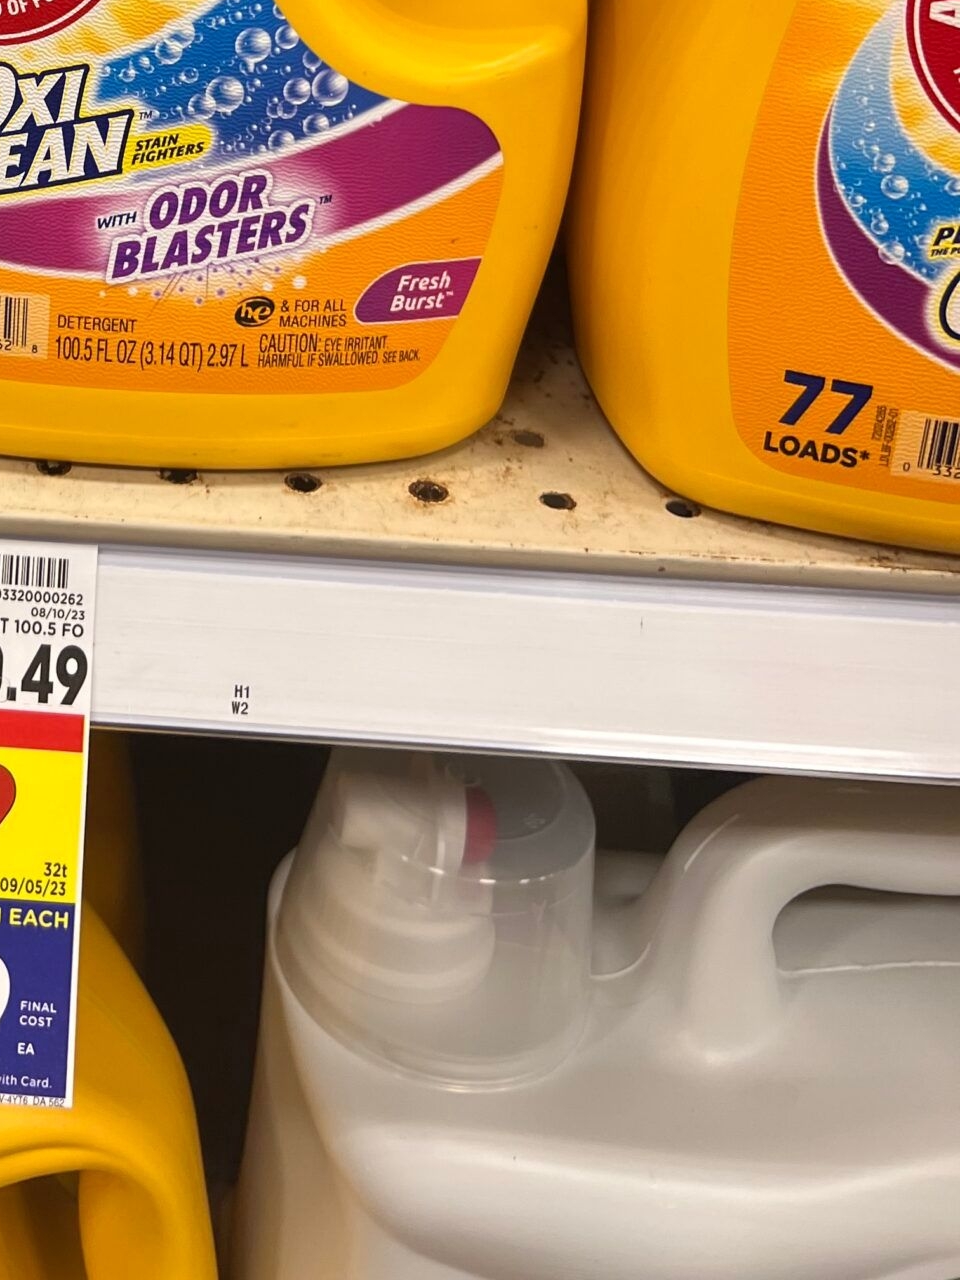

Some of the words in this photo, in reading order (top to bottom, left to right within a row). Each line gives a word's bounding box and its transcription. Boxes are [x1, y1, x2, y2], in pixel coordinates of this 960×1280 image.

[7, 0, 28, 17] OF
[135, 134, 179, 152] STAIN
[131, 142, 205, 166] FIGHTERS
[98, 212, 137, 229] WITH
[150, 175, 267, 231] ODOR
[112, 204, 310, 279] BLASTERS
[397, 271, 451, 292] Fresh
[281, 301, 290, 313] &
[294, 300, 320, 313] FOR
[324, 300, 347, 312] ALL
[57, 314, 138, 333] DETERGENT
[280, 314, 347, 328] MACHINES
[259, 334, 321, 353] CAUTION:
[324, 338, 341, 352] EYE
[344, 336, 389, 351] IRRITANT.
[56, 336, 92, 362] 100.5
[97, 339, 113, 363] FL
[117, 340, 137, 364] OZ
[140, 342, 175, 370] (3.14
[179, 342, 203, 373] QT)
[207, 344, 238, 368] 2.97
[241, 344, 249, 367] L
[258, 352, 304, 368] HARMFUL
[308, 353, 316, 367] IF
[318, 350, 379, 366] SWALLOWED.
[382, 350, 397, 364] SEE
[399, 349, 420, 361] BACK.
[778, 370, 874, 435] 77
[30, 606, 86, 621] 08/10/23
[14, 620, 57, 636] 100.5
[62, 622, 84, 638] FO
[234, 684, 250, 699] H1
[232, 701, 249, 715] W2
[44, 862, 67, 878] 32t
[0, 878, 67, 897] 09/05/23
[10, 908, 69, 928] EACH
[20, 1000, 57, 1013] FINAL
[20, 1015, 53, 1028] COST
[17, 1042, 35, 1056] EA
[20, 1076, 53, 1089] Card.
